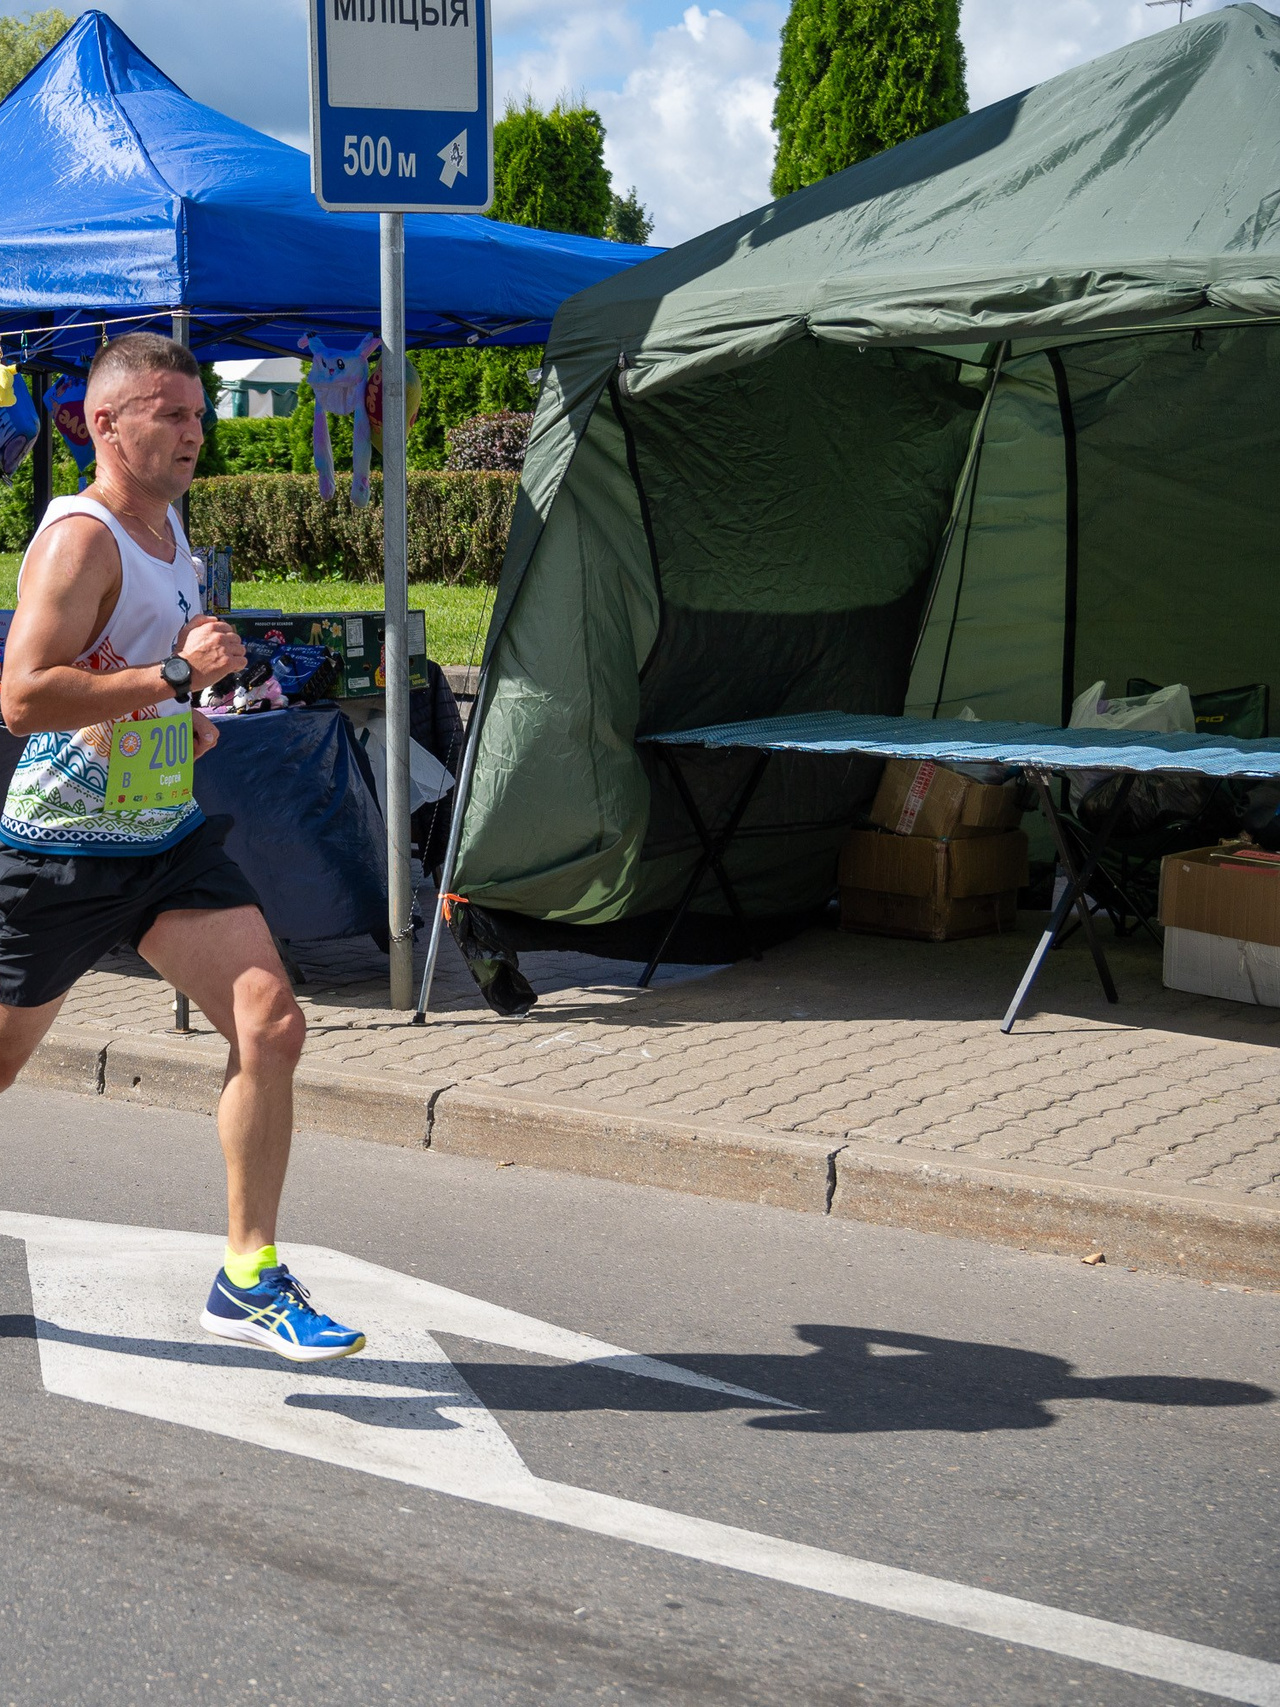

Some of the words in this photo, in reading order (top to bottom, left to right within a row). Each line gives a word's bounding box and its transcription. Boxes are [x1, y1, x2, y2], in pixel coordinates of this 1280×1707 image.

[334, 0, 469, 31] МІЛІЦЫЯ
[343, 135, 392, 177] 500
[398, 152, 417, 178] м
[58, 408, 90, 439] ove
[148, 721, 188, 770] 200
[122, 771, 132, 788] B
